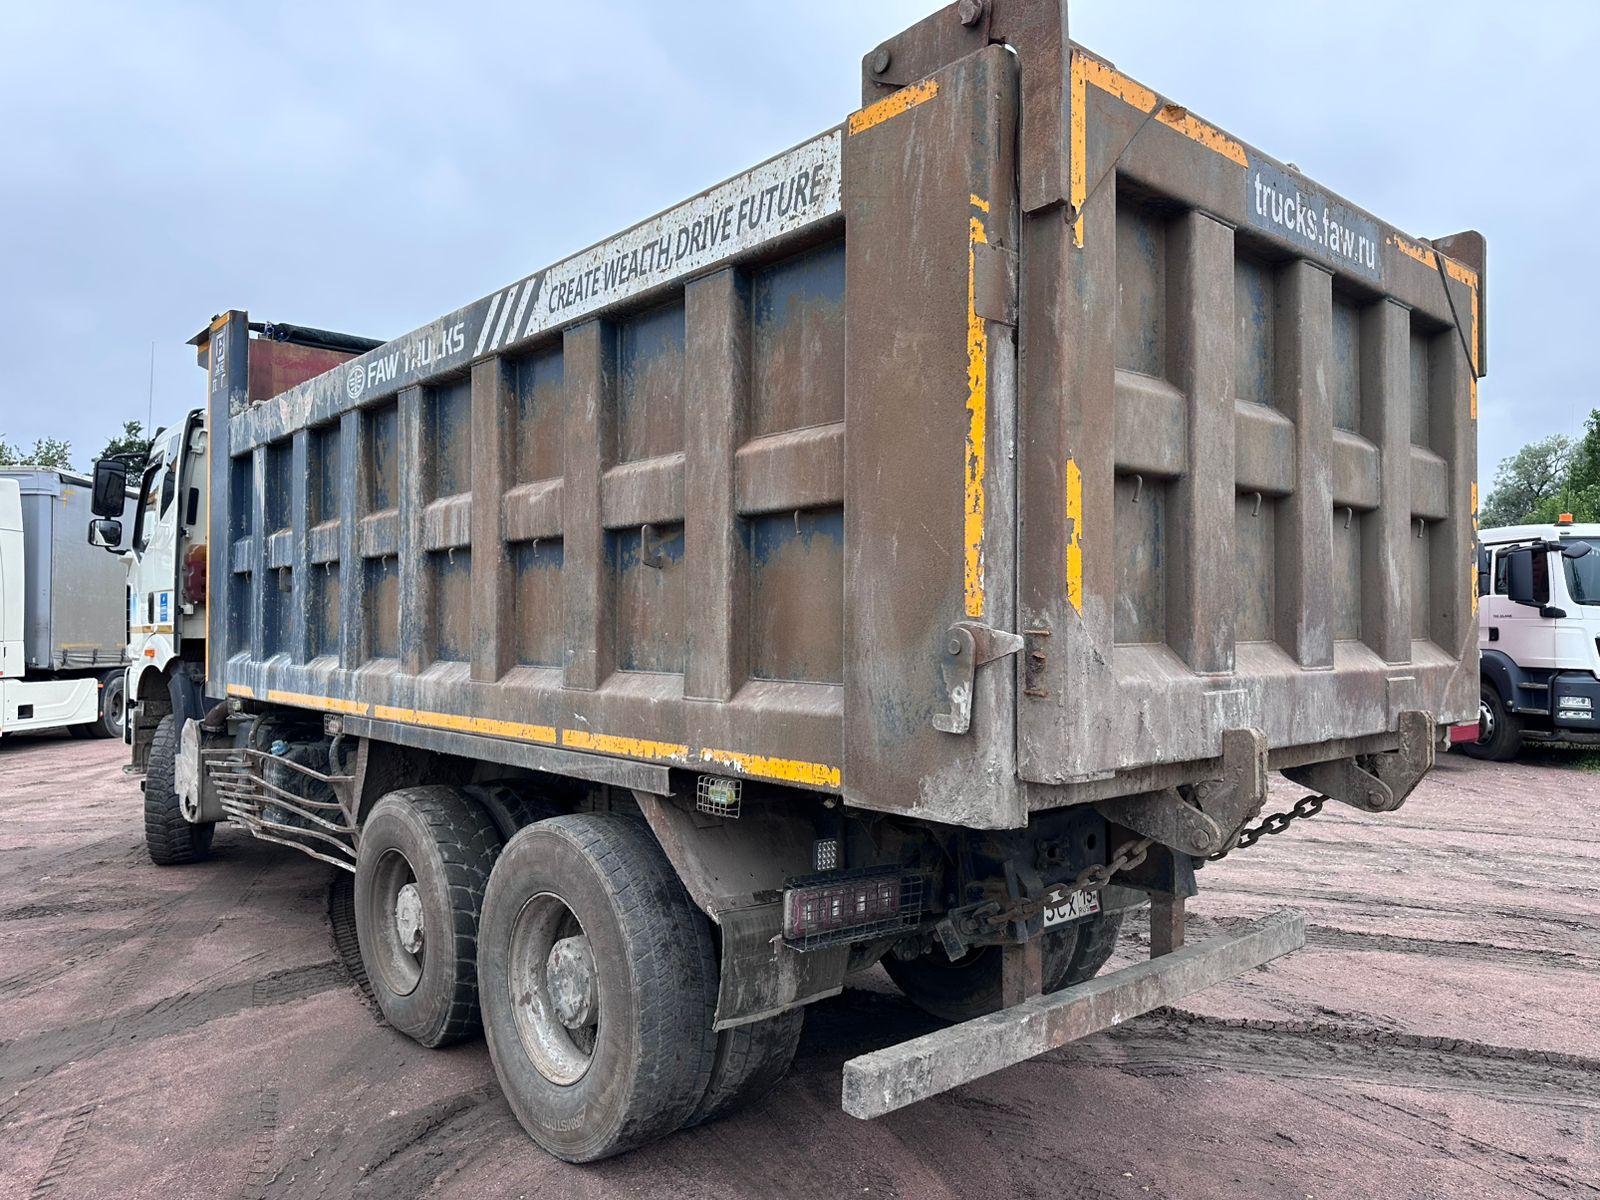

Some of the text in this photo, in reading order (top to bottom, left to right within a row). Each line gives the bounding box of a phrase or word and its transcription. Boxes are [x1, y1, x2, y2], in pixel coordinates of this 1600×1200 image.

[548, 265, 601, 313] CREATE
[736, 163, 824, 236] FUTURE
[1254, 173, 1375, 270] trucks.faw.ru
[367, 322, 465, 388] FAW TRUKS
